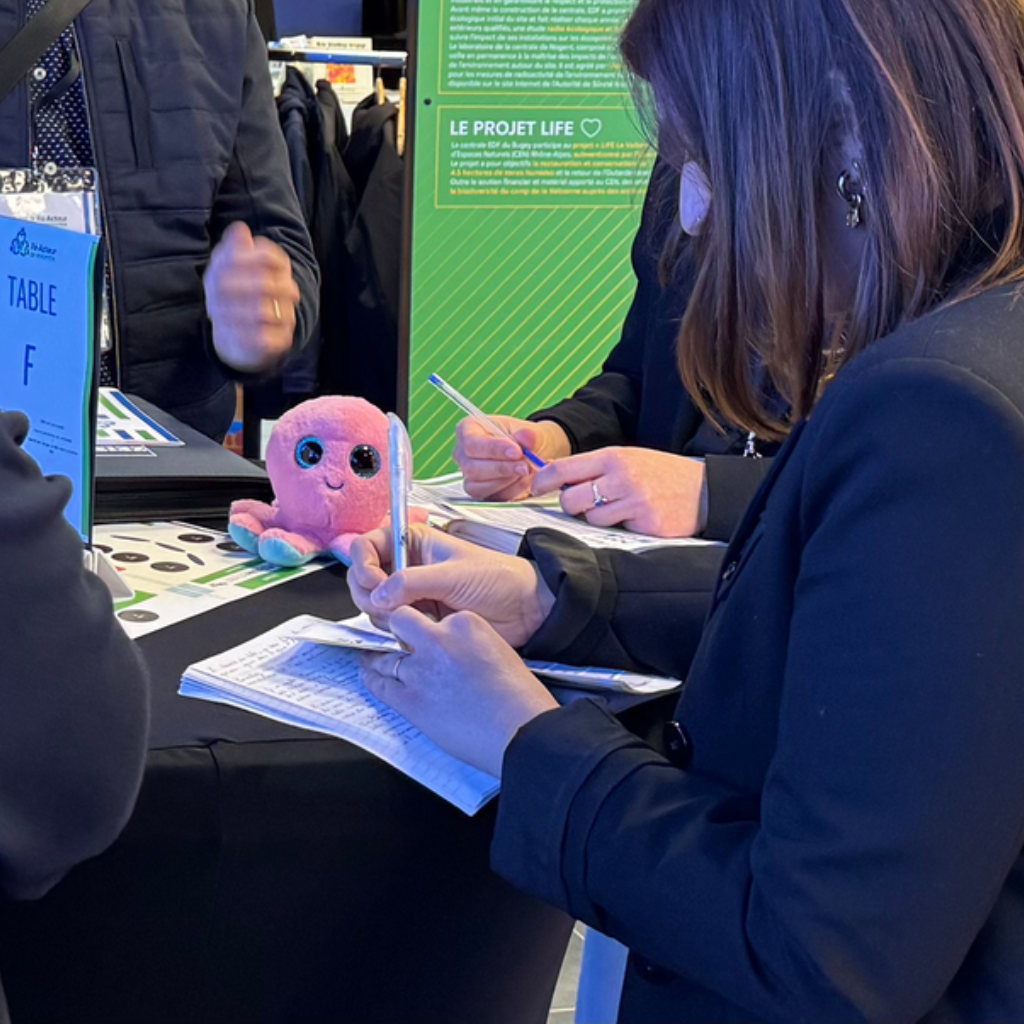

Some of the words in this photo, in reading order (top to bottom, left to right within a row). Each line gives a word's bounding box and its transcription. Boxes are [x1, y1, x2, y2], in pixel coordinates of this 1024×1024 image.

[450, 120, 468, 136] LE
[473, 120, 537, 136] PROJET
[541, 120, 574, 136] LIFE
[7, 275, 57, 316] TABLE
[23, 344, 36, 386] F
